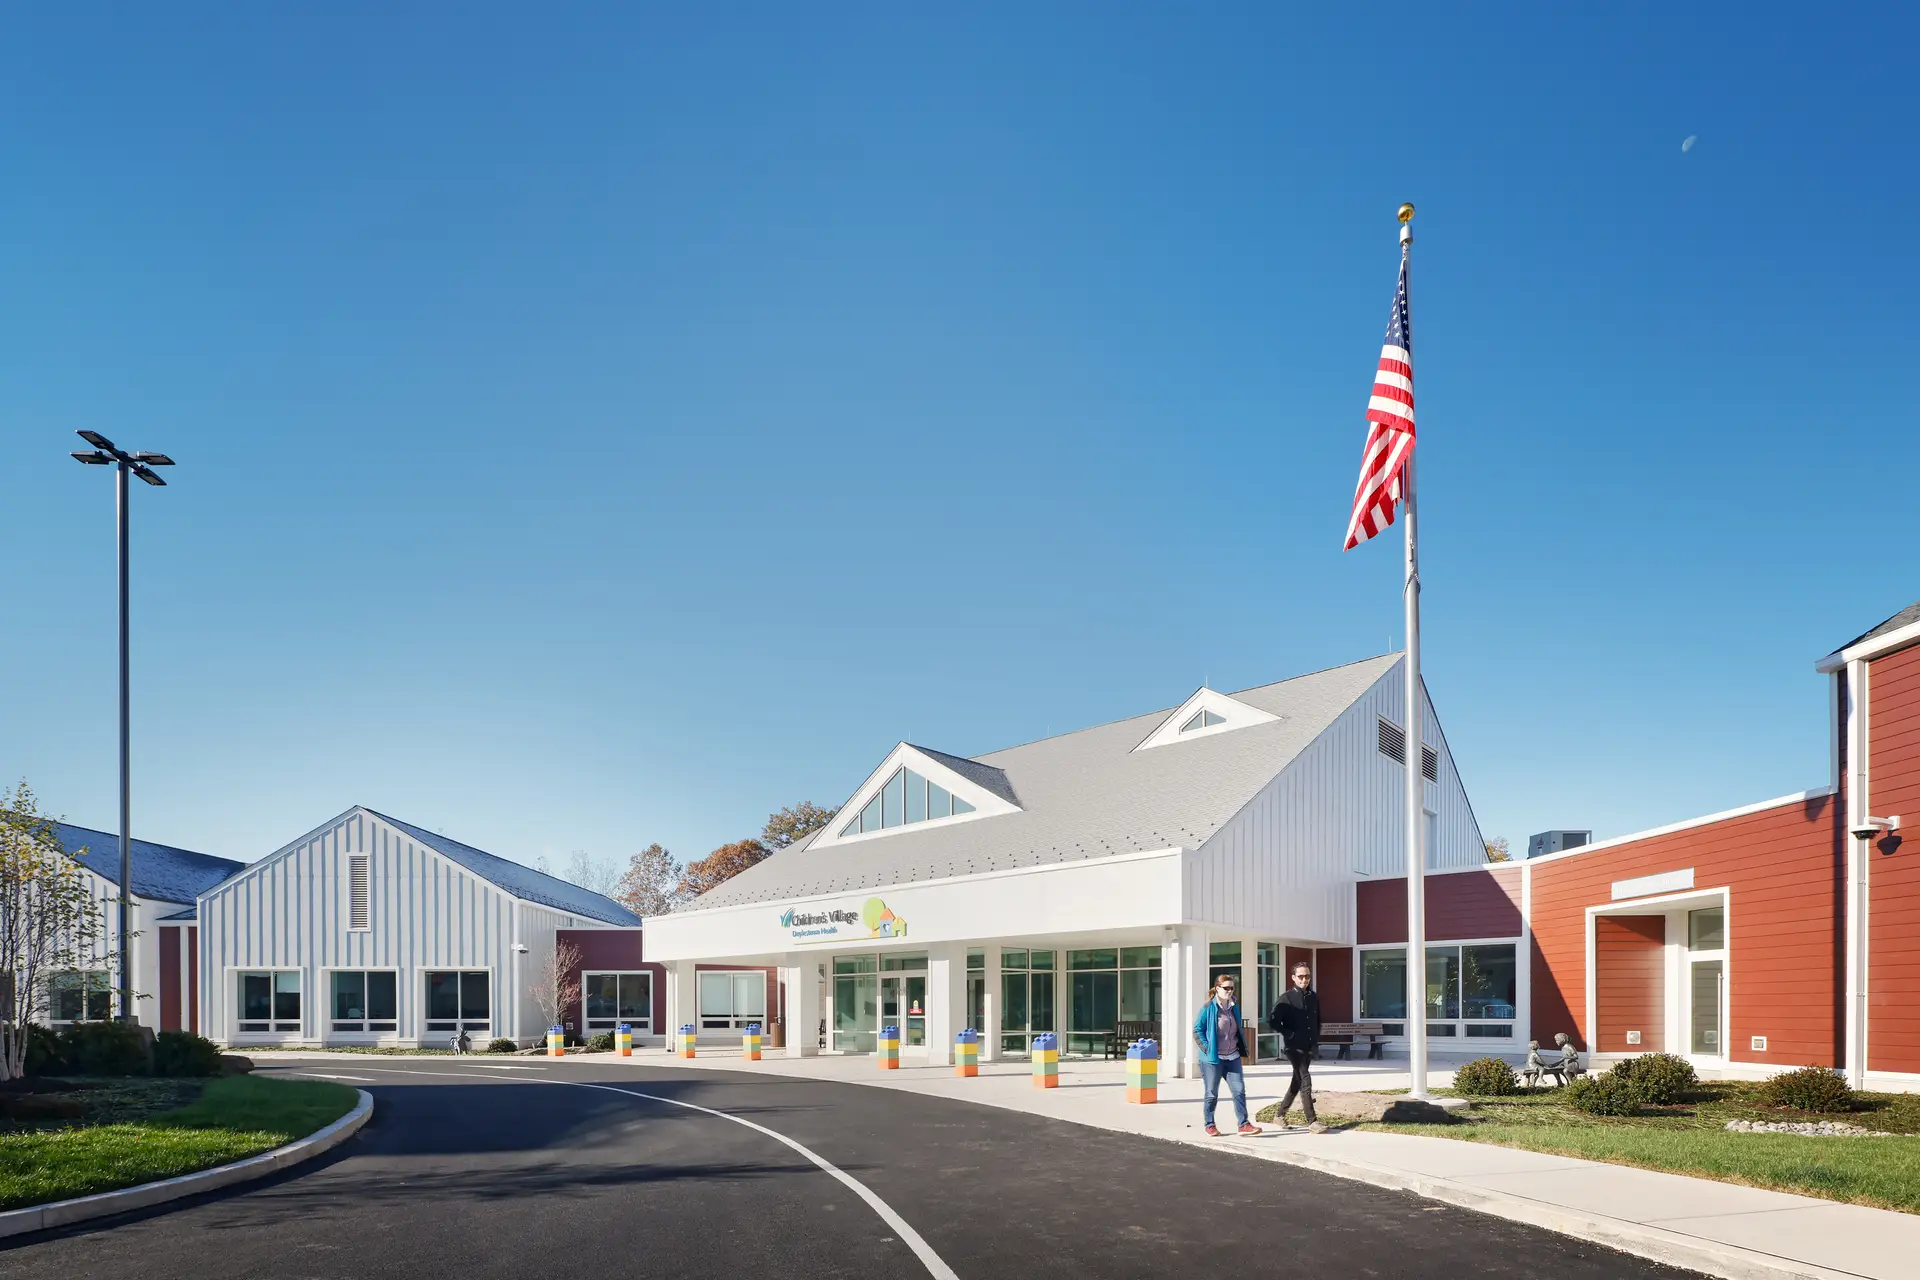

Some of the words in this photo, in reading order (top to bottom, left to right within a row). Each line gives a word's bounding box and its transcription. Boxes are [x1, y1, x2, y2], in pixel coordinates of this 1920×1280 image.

[792, 912, 828, 926] Children's
[829, 910, 858, 925] Village
[821, 926, 837, 934] Health
